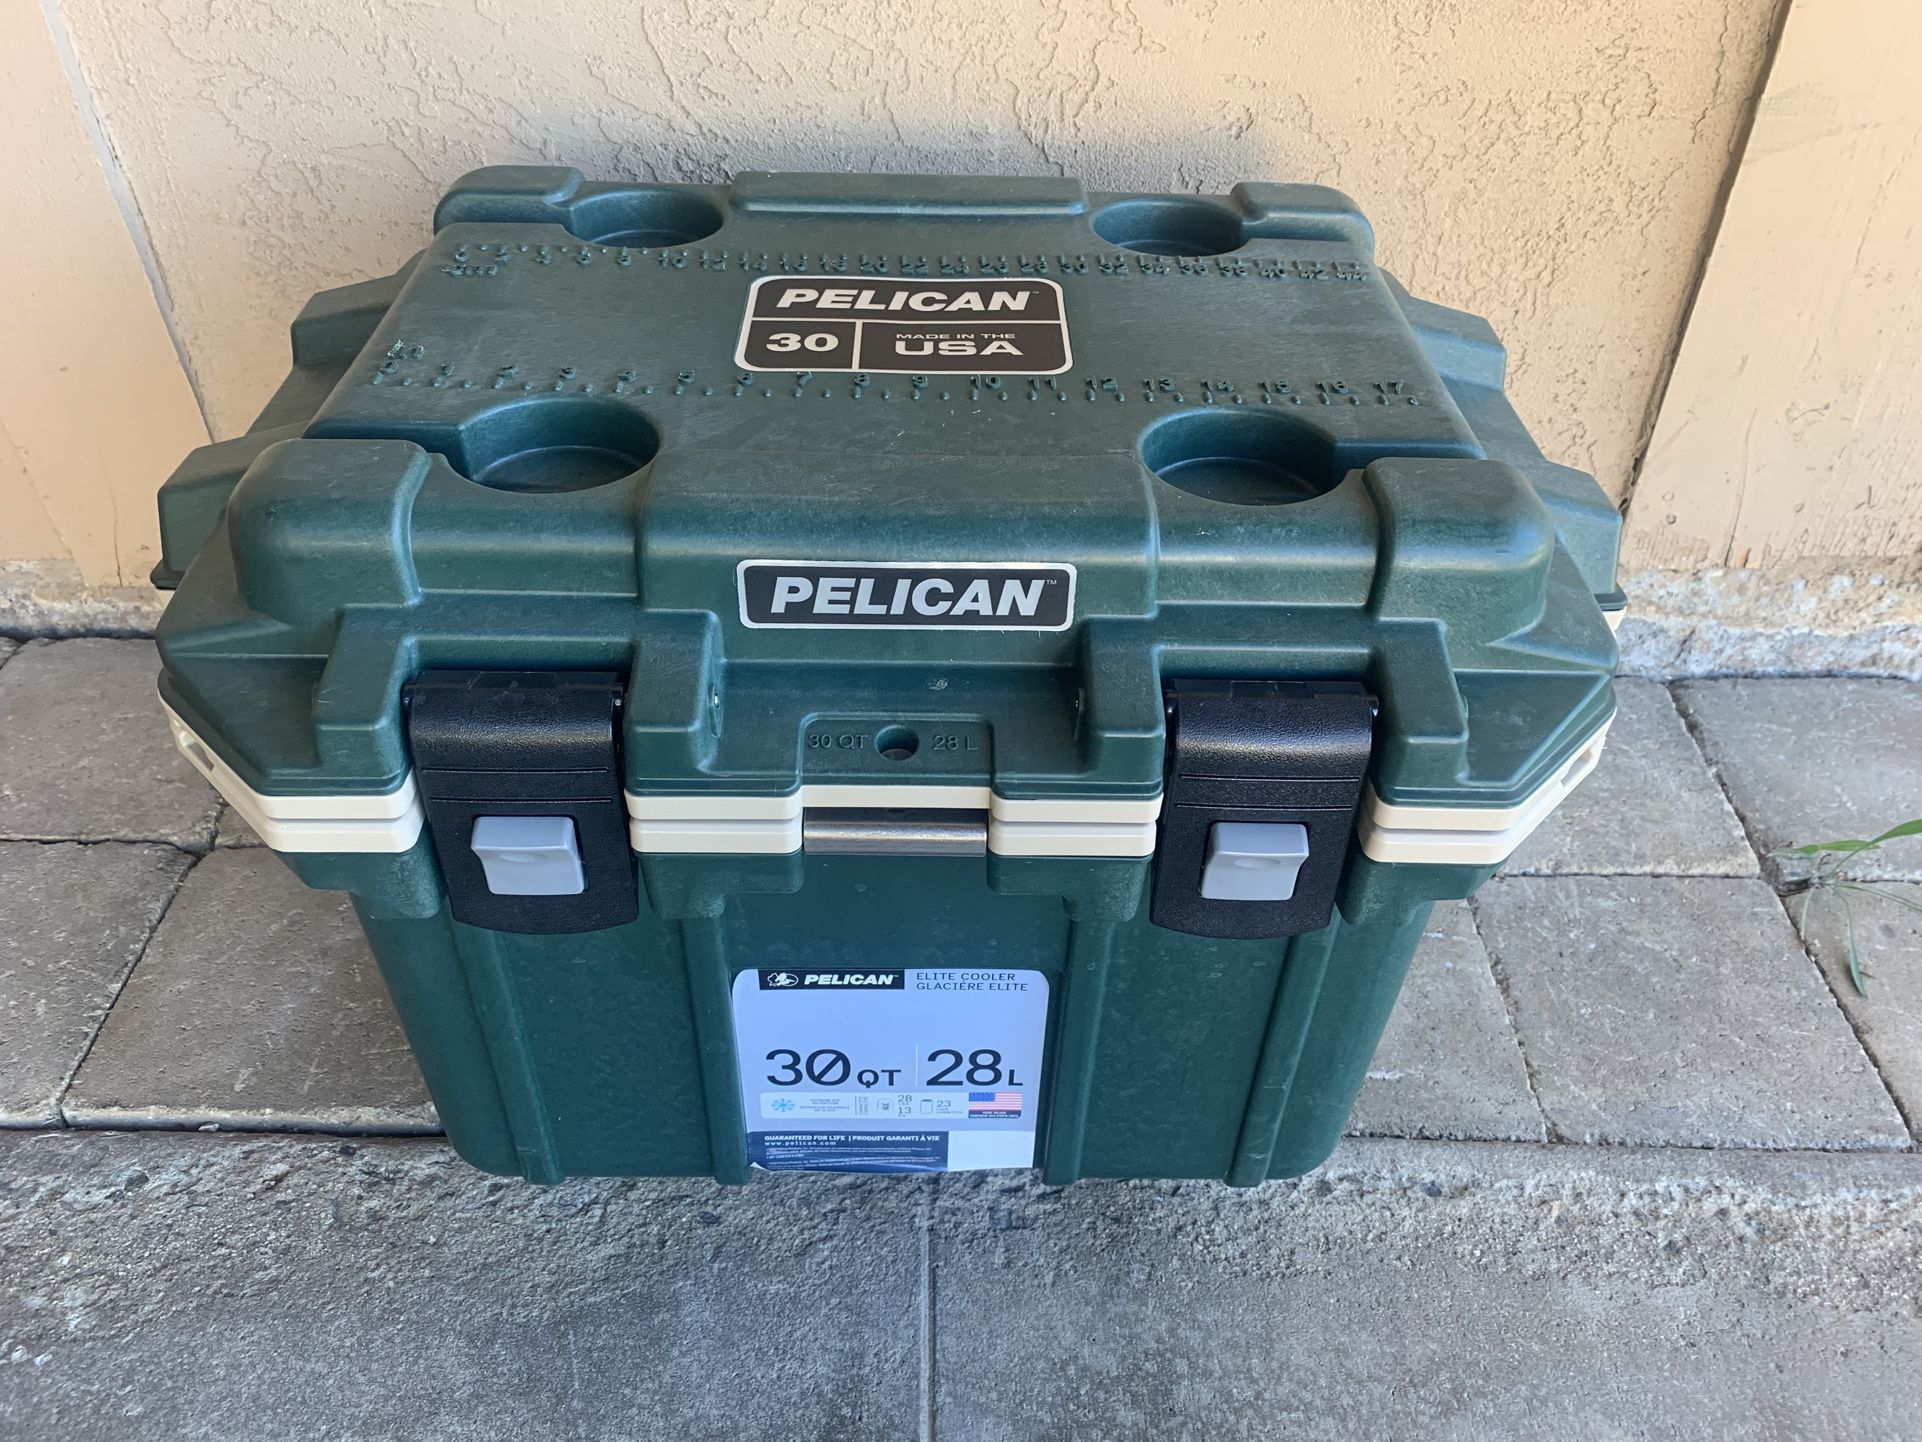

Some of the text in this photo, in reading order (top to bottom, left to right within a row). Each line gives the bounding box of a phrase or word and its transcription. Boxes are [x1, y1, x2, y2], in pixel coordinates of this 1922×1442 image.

[776, 288, 1031, 312] PELICAN
[766, 333, 839, 352] 30
[895, 340, 1024, 356] USA
[970, 374, 1001, 390] 10
[1028, 376, 1056, 391] 11
[1086, 376, 1117, 393] 12
[1143, 377, 1176, 393] 13
[1201, 378, 1235, 393] 14
[1315, 380, 1349, 395] 16
[1373, 380, 1404, 395] 17
[770, 576, 1046, 616] PELICAN
[808, 734, 868, 750] 30 QT
[933, 735, 978, 750] 28 L
[803, 974, 893, 985] PELICAN
[916, 972, 1016, 981] ELITE COOLER
[916, 980, 1028, 991] GLACIÈRE ELITE
[765, 1048, 902, 1088] 30 QT
[926, 1048, 1024, 1087] 28 L
[898, 1094, 912, 1102] 28
[937, 1100, 952, 1108] 23
[898, 1106, 912, 1114] 13
